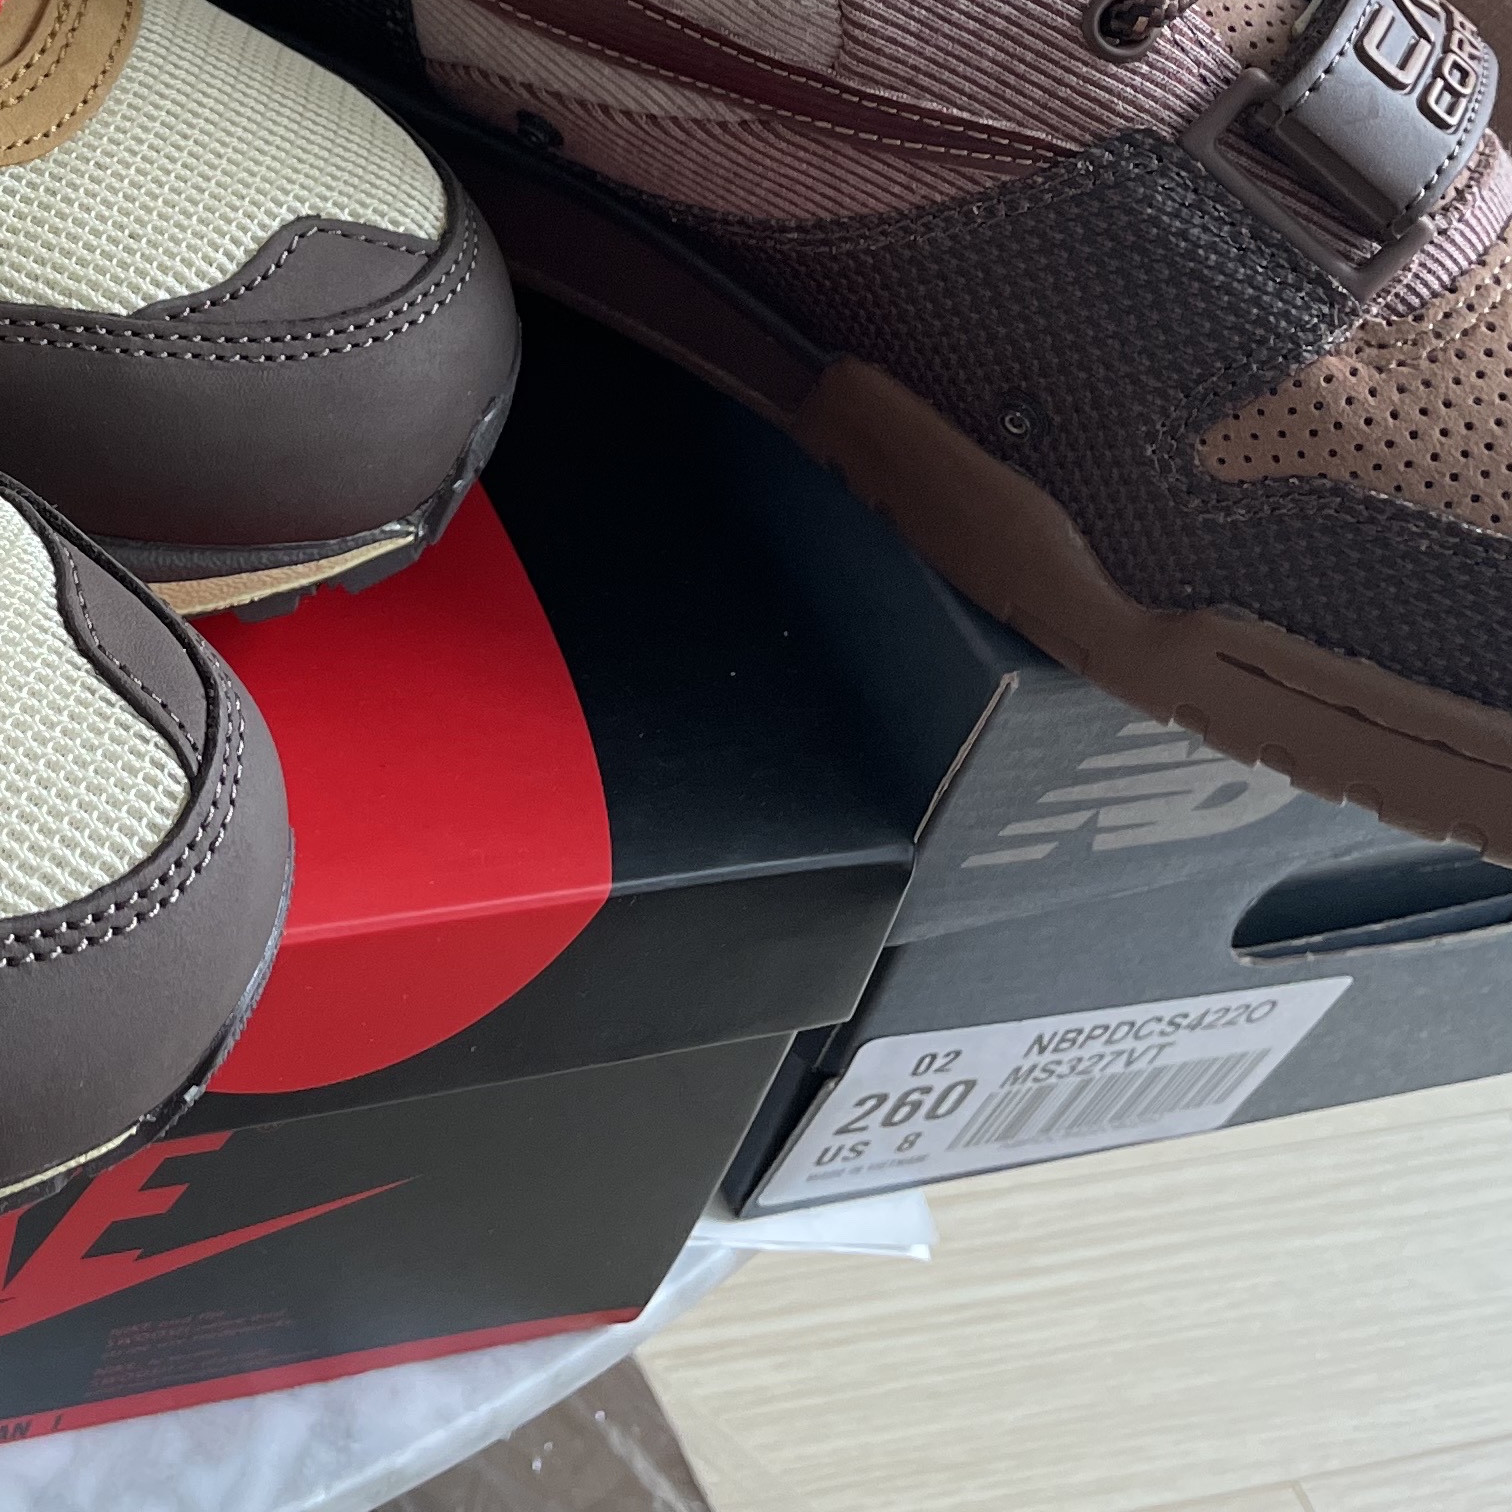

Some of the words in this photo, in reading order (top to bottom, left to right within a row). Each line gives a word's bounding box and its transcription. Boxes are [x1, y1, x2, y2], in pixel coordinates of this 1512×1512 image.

[910, 1049, 963, 1077] 02
[998, 1040, 1177, 1089] MS327VT
[833, 1079, 978, 1136] 260
[815, 1140, 871, 1167] US
[894, 1131, 923, 1153] 8
